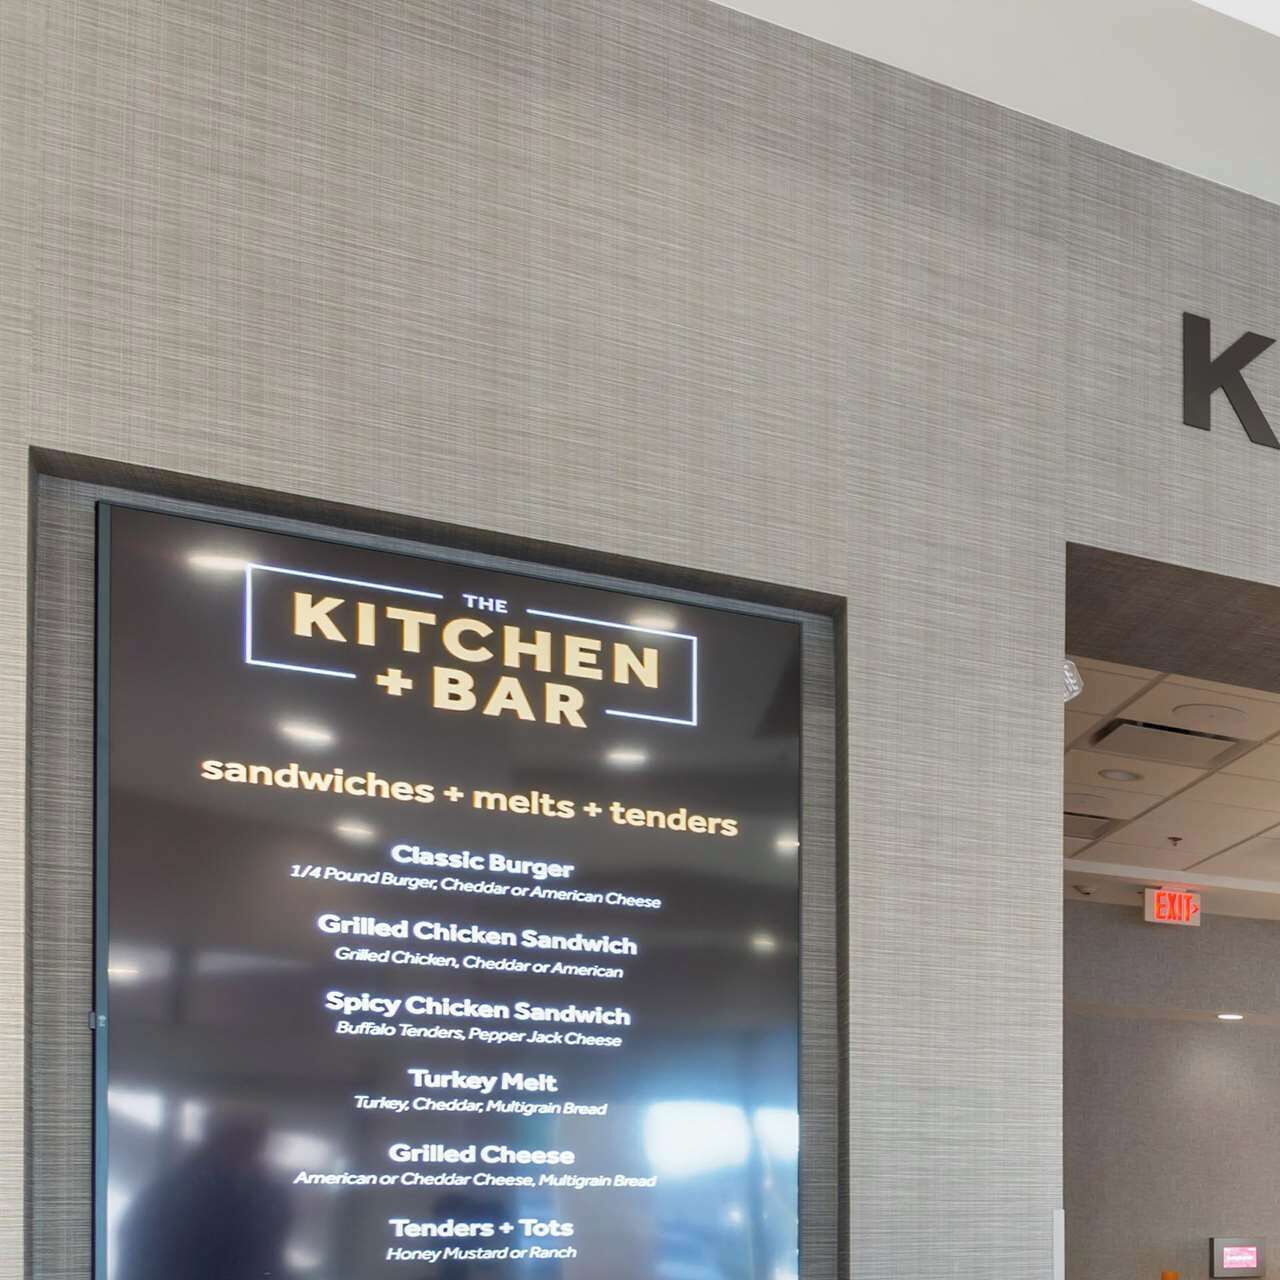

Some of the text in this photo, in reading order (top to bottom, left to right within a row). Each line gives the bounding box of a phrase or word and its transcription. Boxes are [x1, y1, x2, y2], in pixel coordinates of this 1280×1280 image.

[462, 593, 508, 614] THE
[293, 591, 659, 689] KITCHEN
[433, 666, 588, 729] BAR
[201, 759, 435, 804] sandwiches
[472, 786, 576, 819] melts
[609, 801, 739, 837] tenders
[391, 844, 574, 880] Classic Burger
[290, 864, 321, 879] 1/4
[323, 867, 380, 884] Pound
[441, 877, 509, 896] Cheddar
[510, 886, 528, 897] or
[529, 886, 603, 904] American
[605, 891, 662, 909] Cheese
[1156, 892, 1192, 921] EXIT
[318, 914, 638, 955] Grilled Chicken Sandwich
[334, 945, 390, 963] Grilled
[463, 954, 531, 973] Cheddar
[532, 962, 551, 974] or
[552, 960, 623, 979] American
[325, 991, 631, 1026] Spicy Chicken Sandwich
[336, 1020, 396, 1038] Buffalo
[469, 1027, 525, 1046] Pepper
[526, 1030, 563, 1045] Jack
[564, 1032, 622, 1048] Cheese
[408, 1069, 559, 1095] Turkey Melt
[486, 1100, 561, 1117] Multigrain
[562, 1101, 607, 1116] Bread
[388, 1143, 575, 1165] Grilled Cheese
[294, 1171, 378, 1186] American
[379, 1175, 399, 1186] or
[400, 1171, 471, 1186] Cheddar
[539, 1173, 612, 1190] Multigrain
[613, 1174, 657, 1188] Bread
[388, 1218, 495, 1238] Tenders
[518, 1218, 574, 1237] Tots
[386, 1245, 577, 1264] Honey Mustard or Ranch
